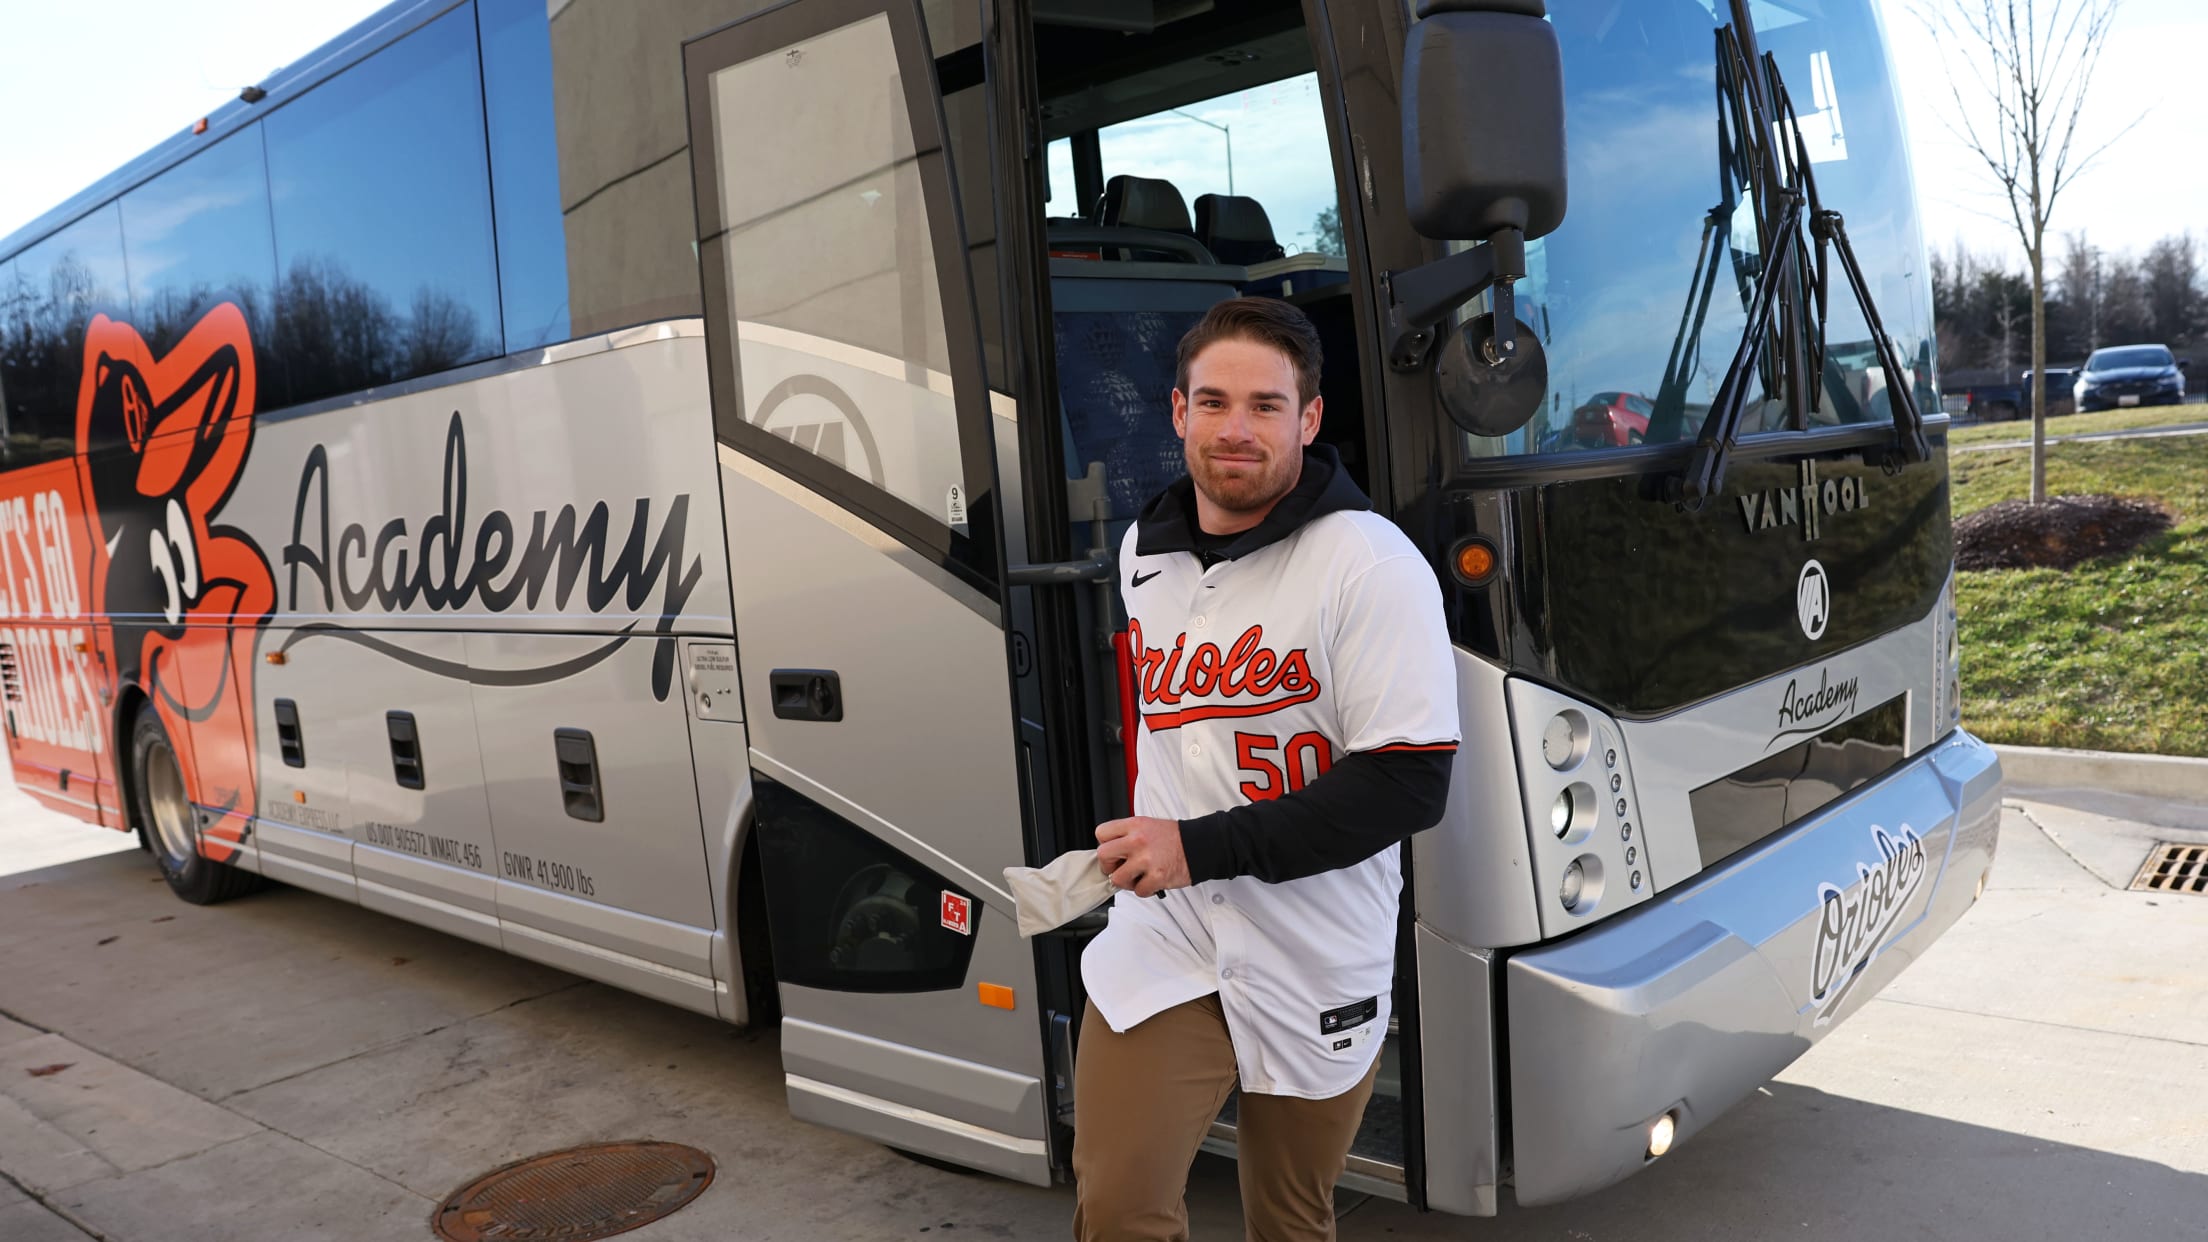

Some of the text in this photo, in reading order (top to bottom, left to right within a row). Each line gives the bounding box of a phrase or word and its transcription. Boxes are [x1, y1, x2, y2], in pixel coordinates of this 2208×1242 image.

[951, 487, 958, 500] 9
[1739, 487, 1799, 533] VAN
[0, 488, 81, 619] T'S GO
[283, 409, 702, 702] Academy
[1778, 667, 1859, 728] Academy
[1234, 730, 1333, 804] 50
[365, 821, 378, 843] US
[377, 823, 394, 847] DOT
[429, 834, 462, 864] WMATC
[463, 842, 482, 869] 456
[503, 851, 595, 896] GVWR 41,900 lbs
[1811, 824, 1926, 1006] Orioles
